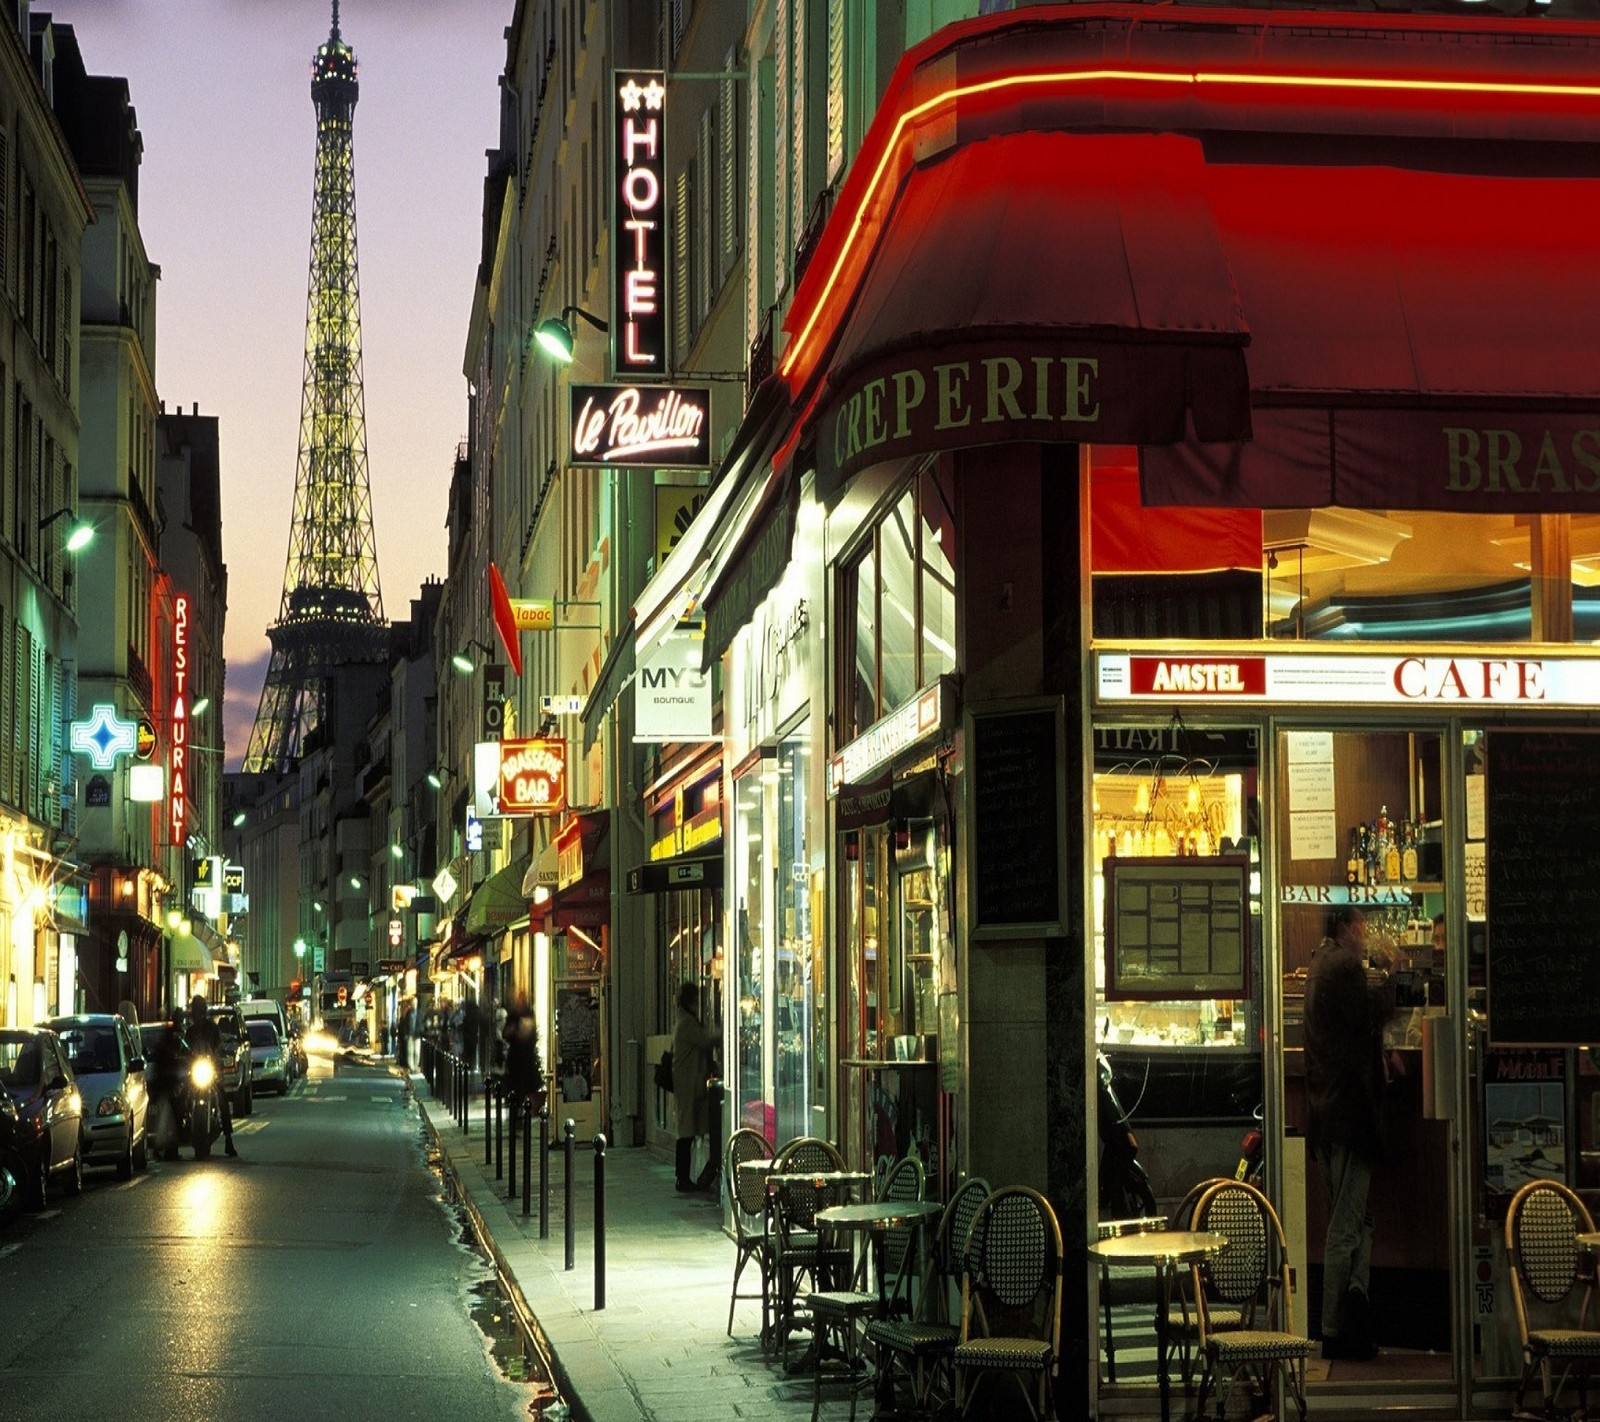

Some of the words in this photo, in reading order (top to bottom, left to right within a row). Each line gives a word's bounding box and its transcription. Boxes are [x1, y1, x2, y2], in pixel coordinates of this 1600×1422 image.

[623, 118, 660, 364] HOTEL
[608, 388, 704, 450] Pavillon
[834, 356, 1101, 468] CREPERIE
[515, 606, 551, 621] Tabac
[1152, 661, 1246, 692] AMSTEL
[1392, 657, 1547, 700] CAFE
[172, 598, 188, 842] RESTAURANT
[501, 749, 564, 782] BRASSERIE
[515, 777, 549, 802] BAR
[1281, 886, 1332, 902] BAR
[1347, 886, 1413, 904] BRAS
